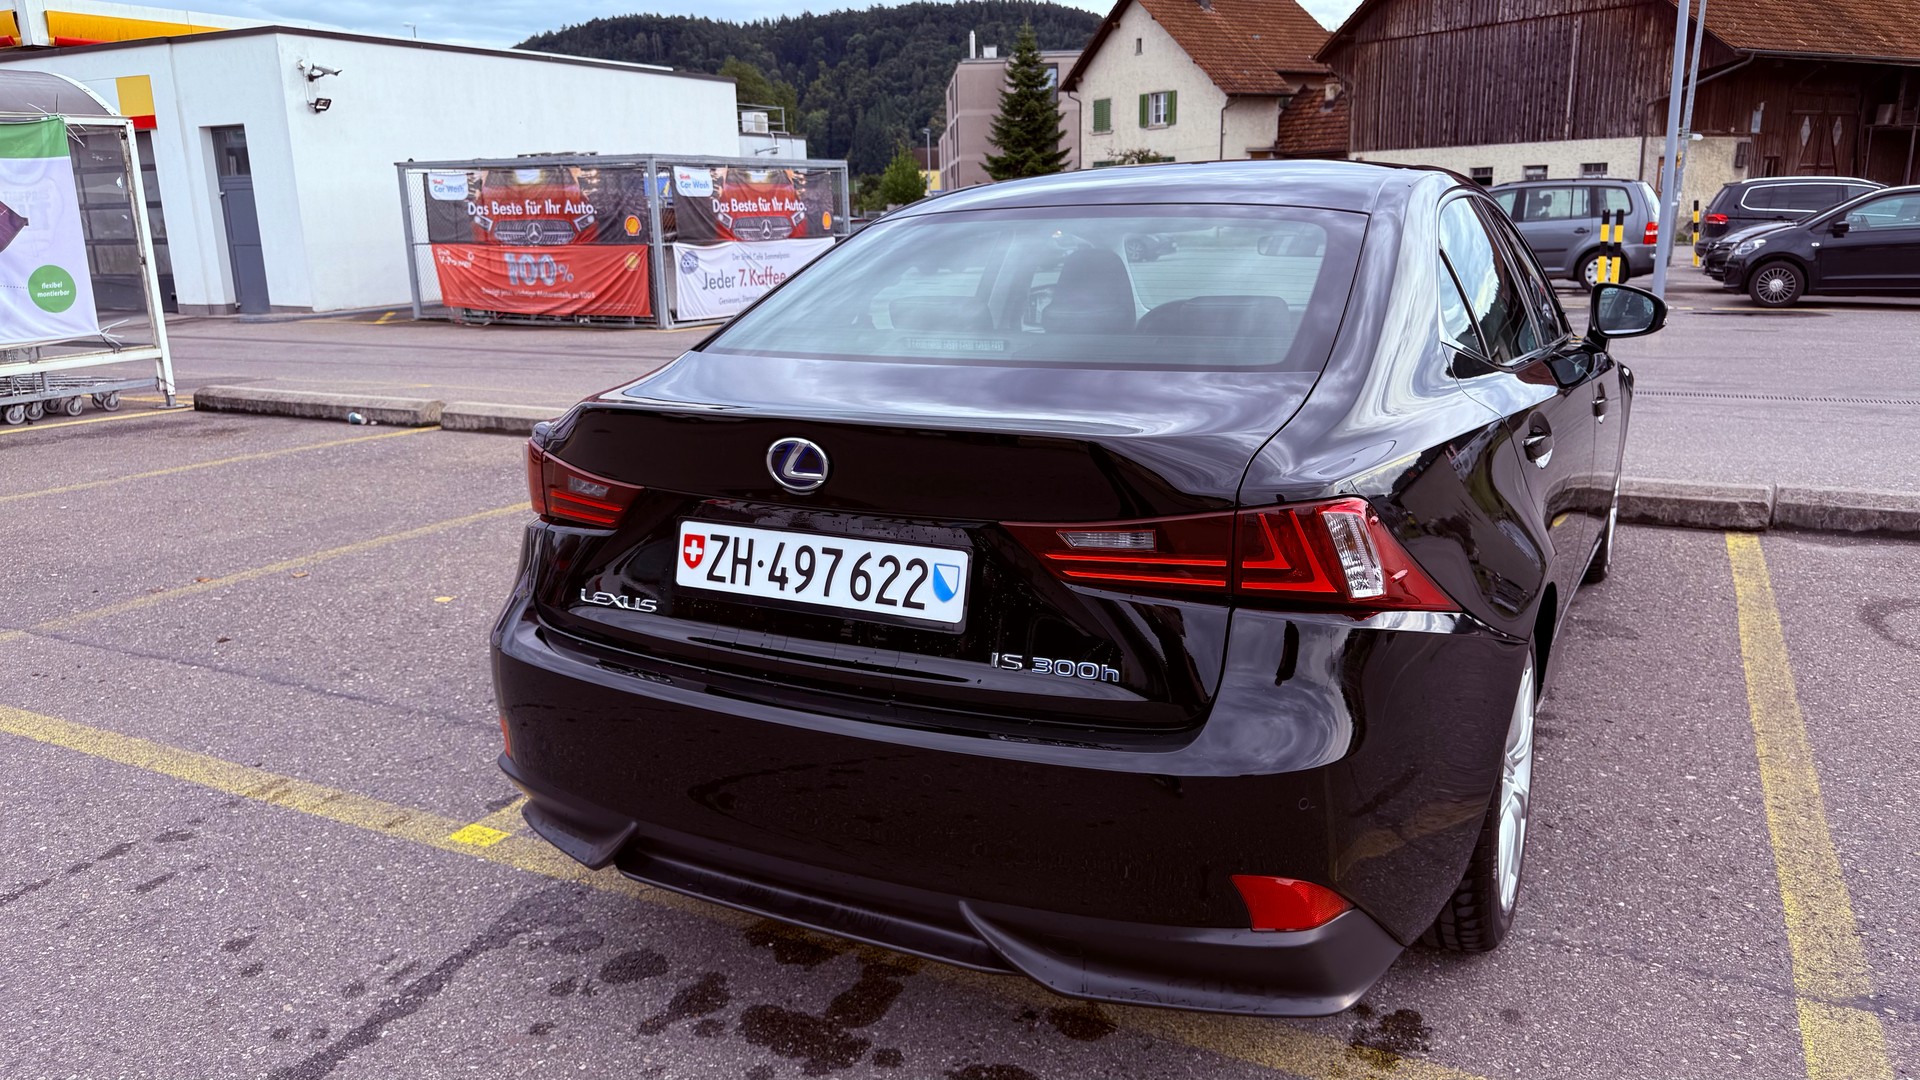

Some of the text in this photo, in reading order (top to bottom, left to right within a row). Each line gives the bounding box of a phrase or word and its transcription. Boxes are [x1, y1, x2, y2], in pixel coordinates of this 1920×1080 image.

[680, 179, 710, 189] Car Wash
[467, 198, 598, 216] Das Beste für Ihr Auto.
[712, 196, 807, 213] Das Beste für Ihr Auto.
[503, 252, 575, 287] 100%
[702, 265, 787, 291] Jeder 7. Kaffee
[37, 289, 70, 298] montierbar
[41, 281, 63, 289] flexibel
[580, 587, 658, 613] LEXUS
[990, 651, 1120, 683] IS 300h
